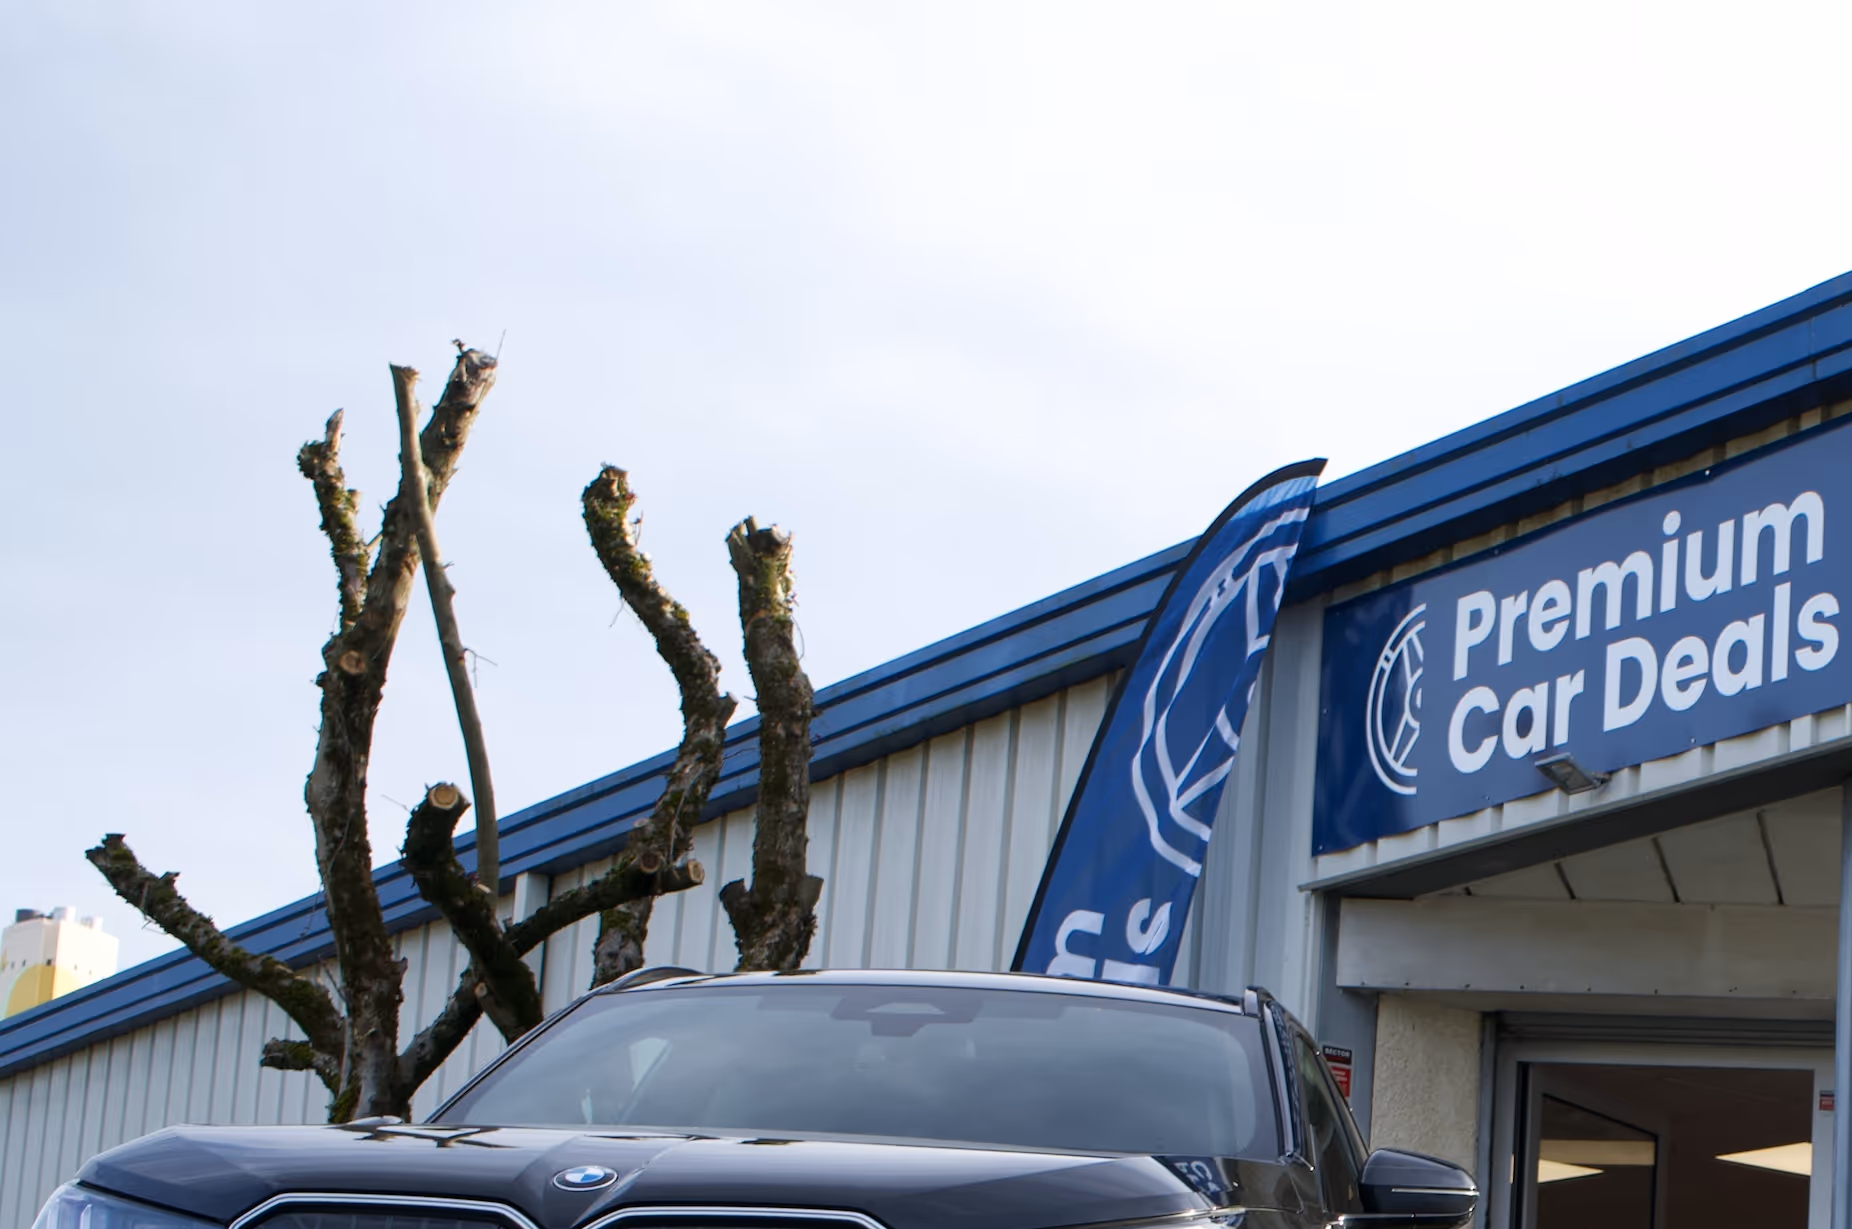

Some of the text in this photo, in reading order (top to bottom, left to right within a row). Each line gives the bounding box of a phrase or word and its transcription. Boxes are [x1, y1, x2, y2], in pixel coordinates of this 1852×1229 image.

[1448, 582, 1840, 774] Car Deals
[1453, 490, 1825, 682] Premium
